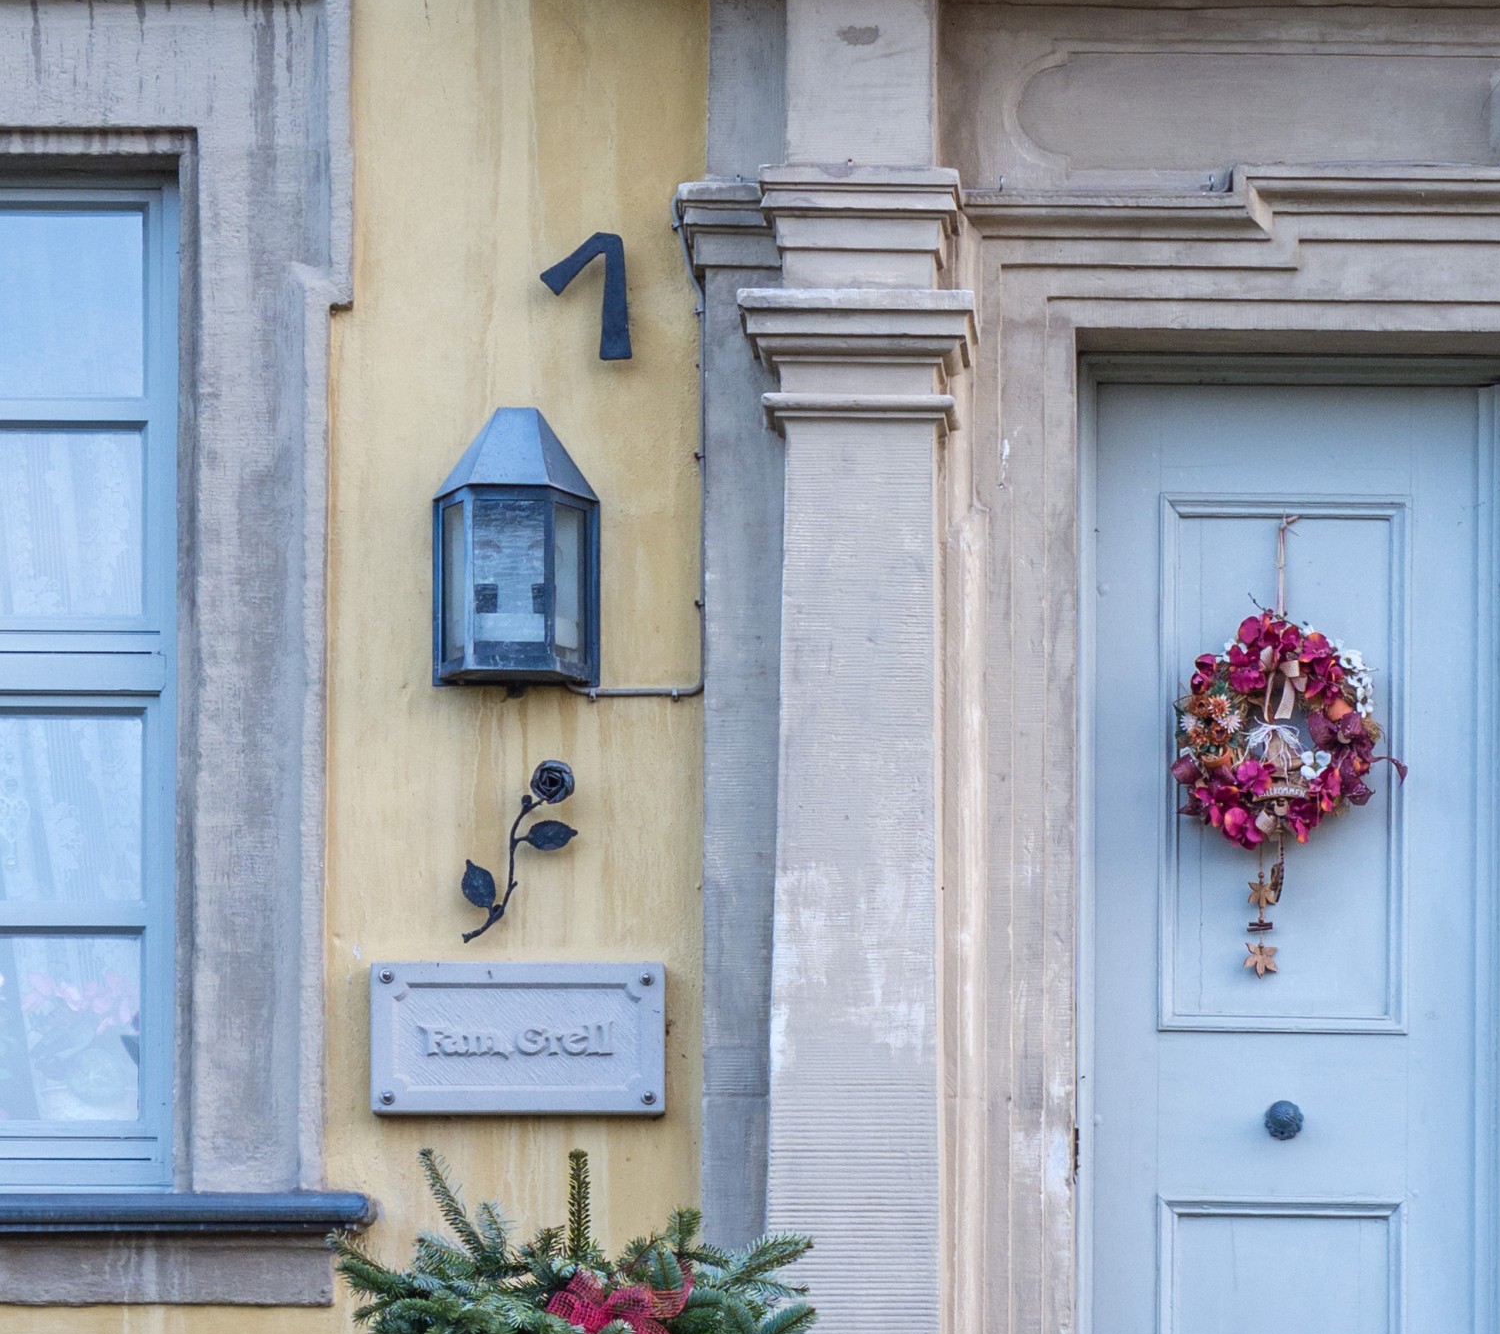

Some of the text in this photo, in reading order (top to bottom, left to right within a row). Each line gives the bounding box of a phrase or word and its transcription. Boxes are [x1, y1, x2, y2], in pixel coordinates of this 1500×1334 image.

[540, 232, 632, 360] 1
[1258, 786, 1306, 798] ILLKOMMEN
[514, 1020, 614, 1057] Grell
